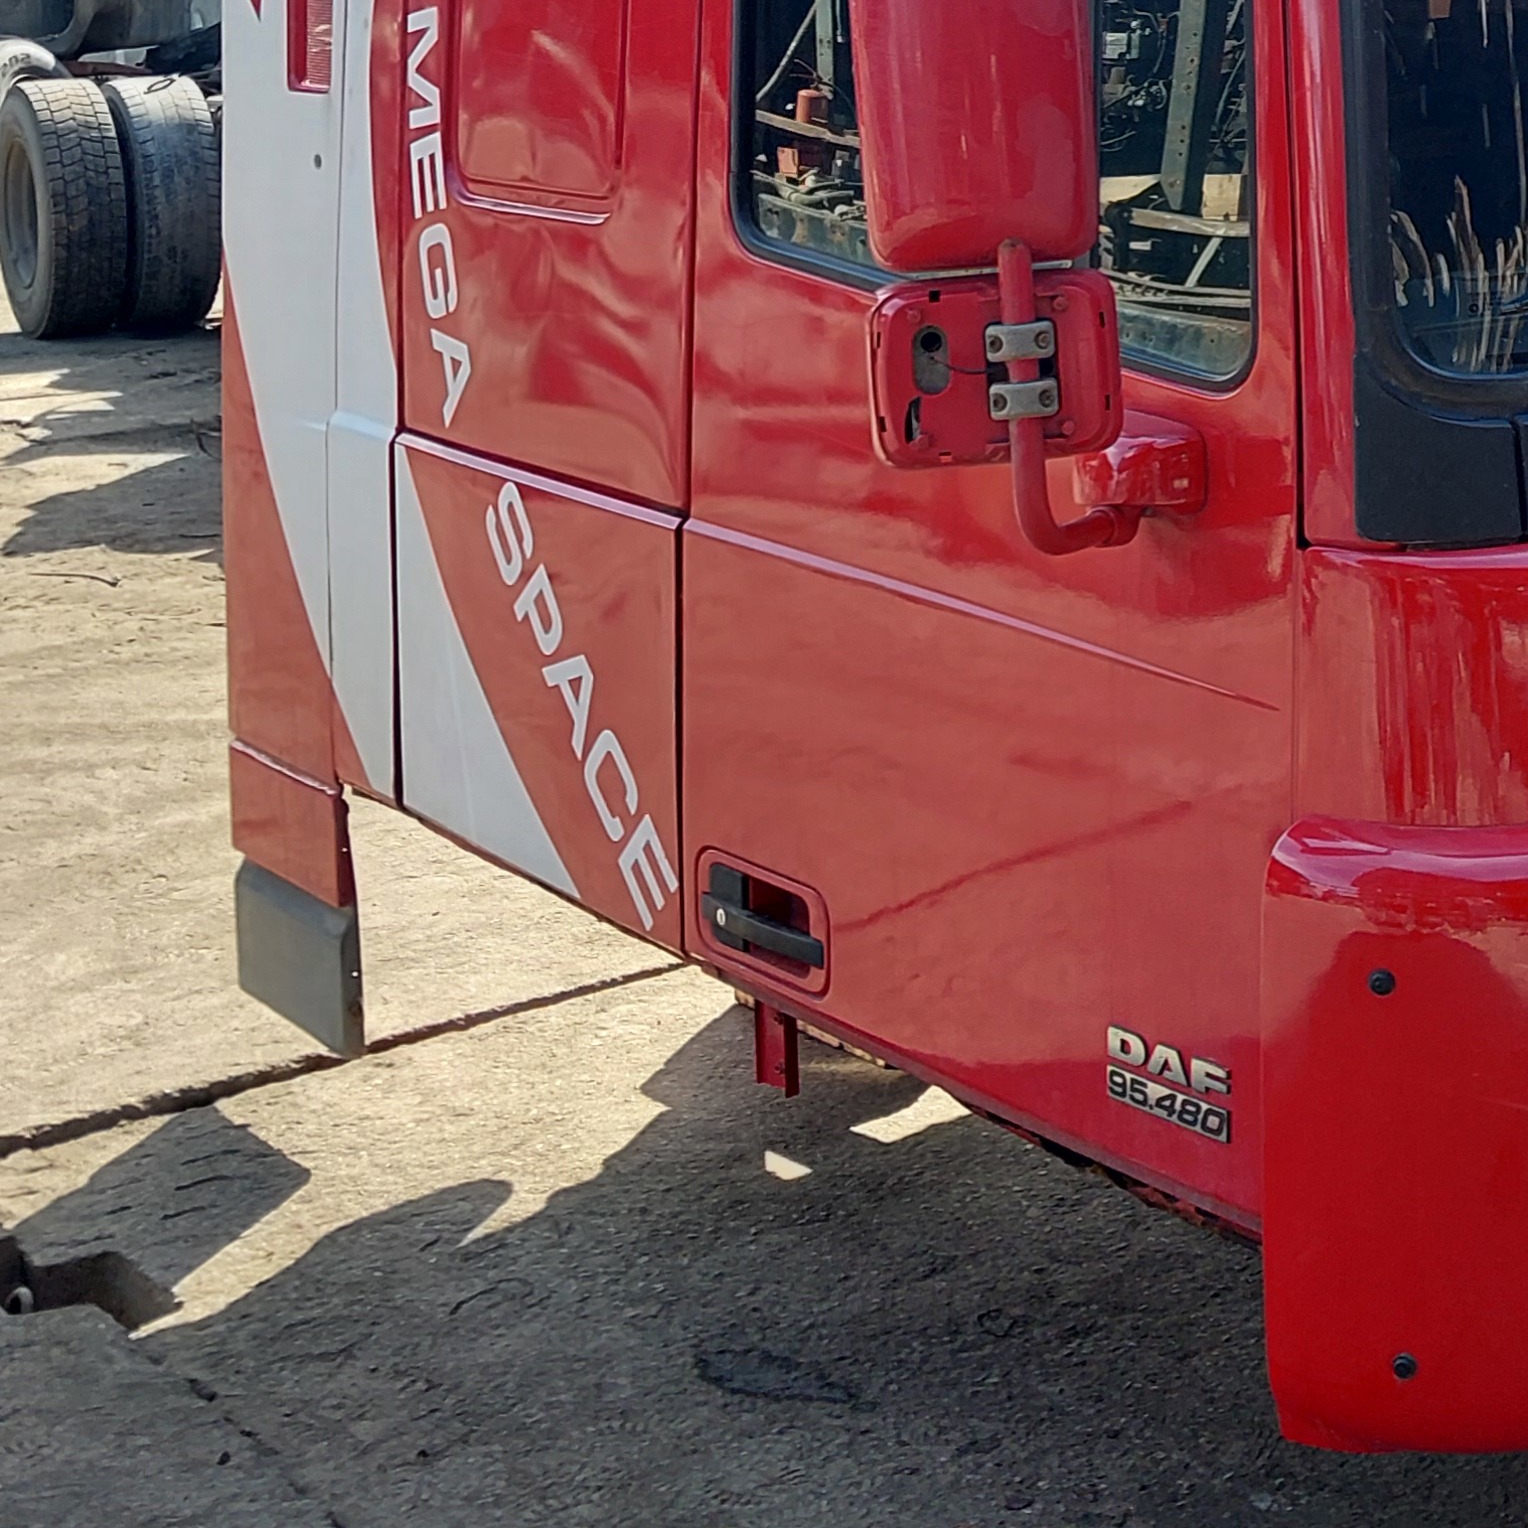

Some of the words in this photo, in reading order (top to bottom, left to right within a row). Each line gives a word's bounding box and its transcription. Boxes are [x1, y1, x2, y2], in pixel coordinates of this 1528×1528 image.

[406, 6, 472, 429] MEGA
[485, 481, 678, 931] SPACE
[1106, 1025, 1232, 1095] DAF
[1108, 1069, 1226, 1137] 95.480
